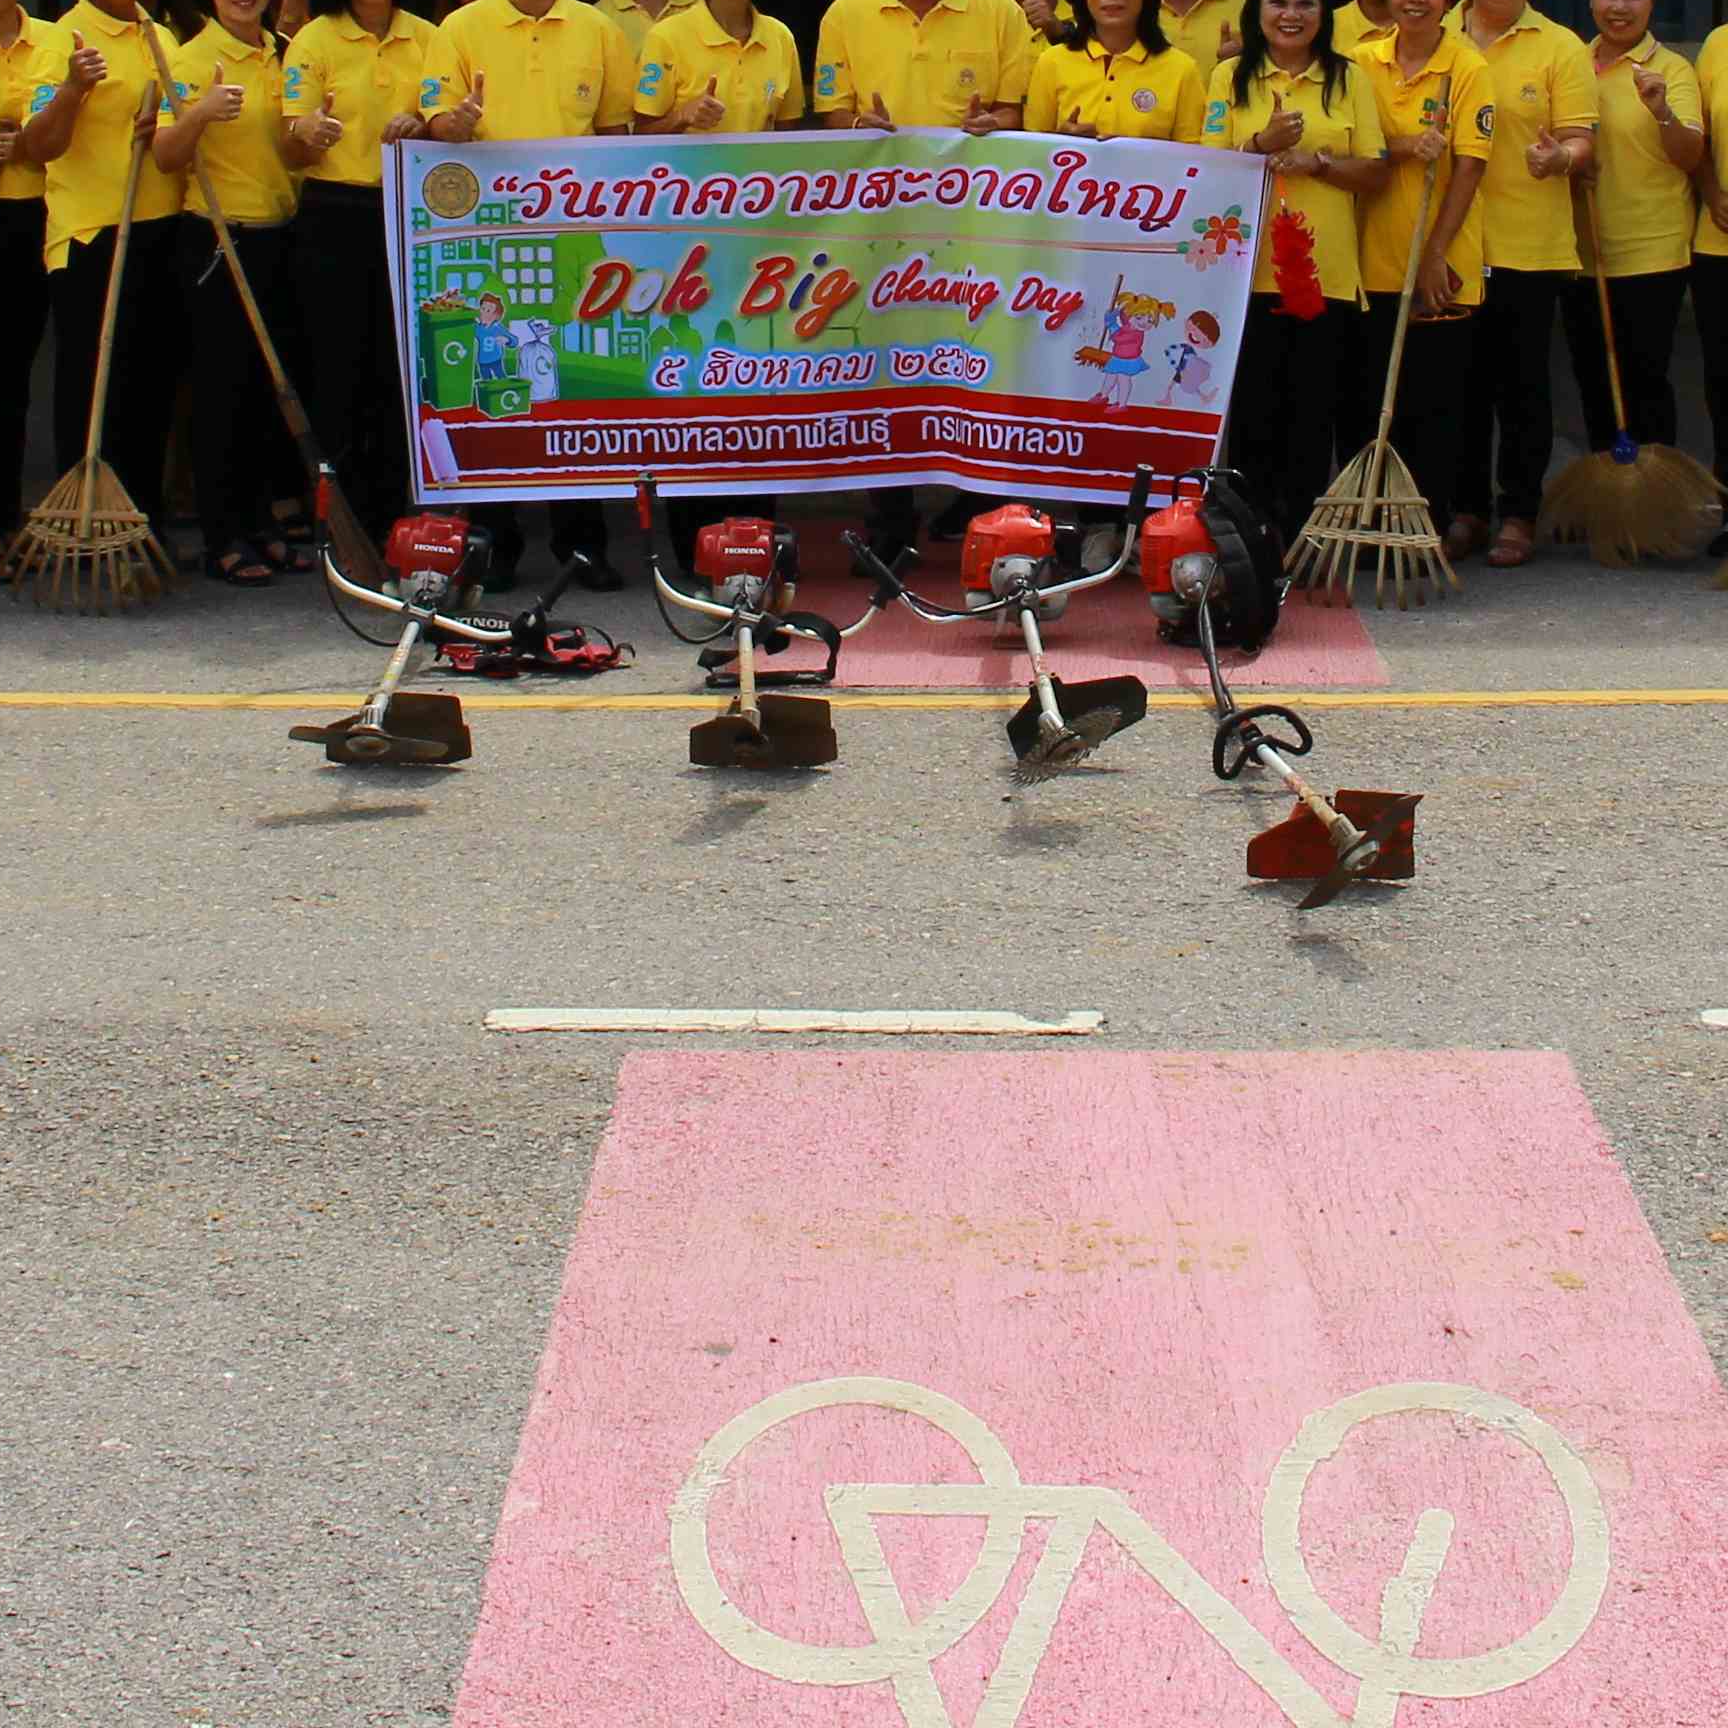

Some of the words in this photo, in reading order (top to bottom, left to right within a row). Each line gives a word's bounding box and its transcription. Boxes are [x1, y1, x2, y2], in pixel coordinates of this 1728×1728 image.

[740, 253, 860, 339] Big
[1011, 278, 1084, 330] Day
[702, 350, 874, 386] สิงหาคม
[545, 413, 892, 456] แขวงทางหลวงกาฬสินธุ์
[414, 543, 455, 554] HONDA
[724, 547, 766, 556] HONDA
